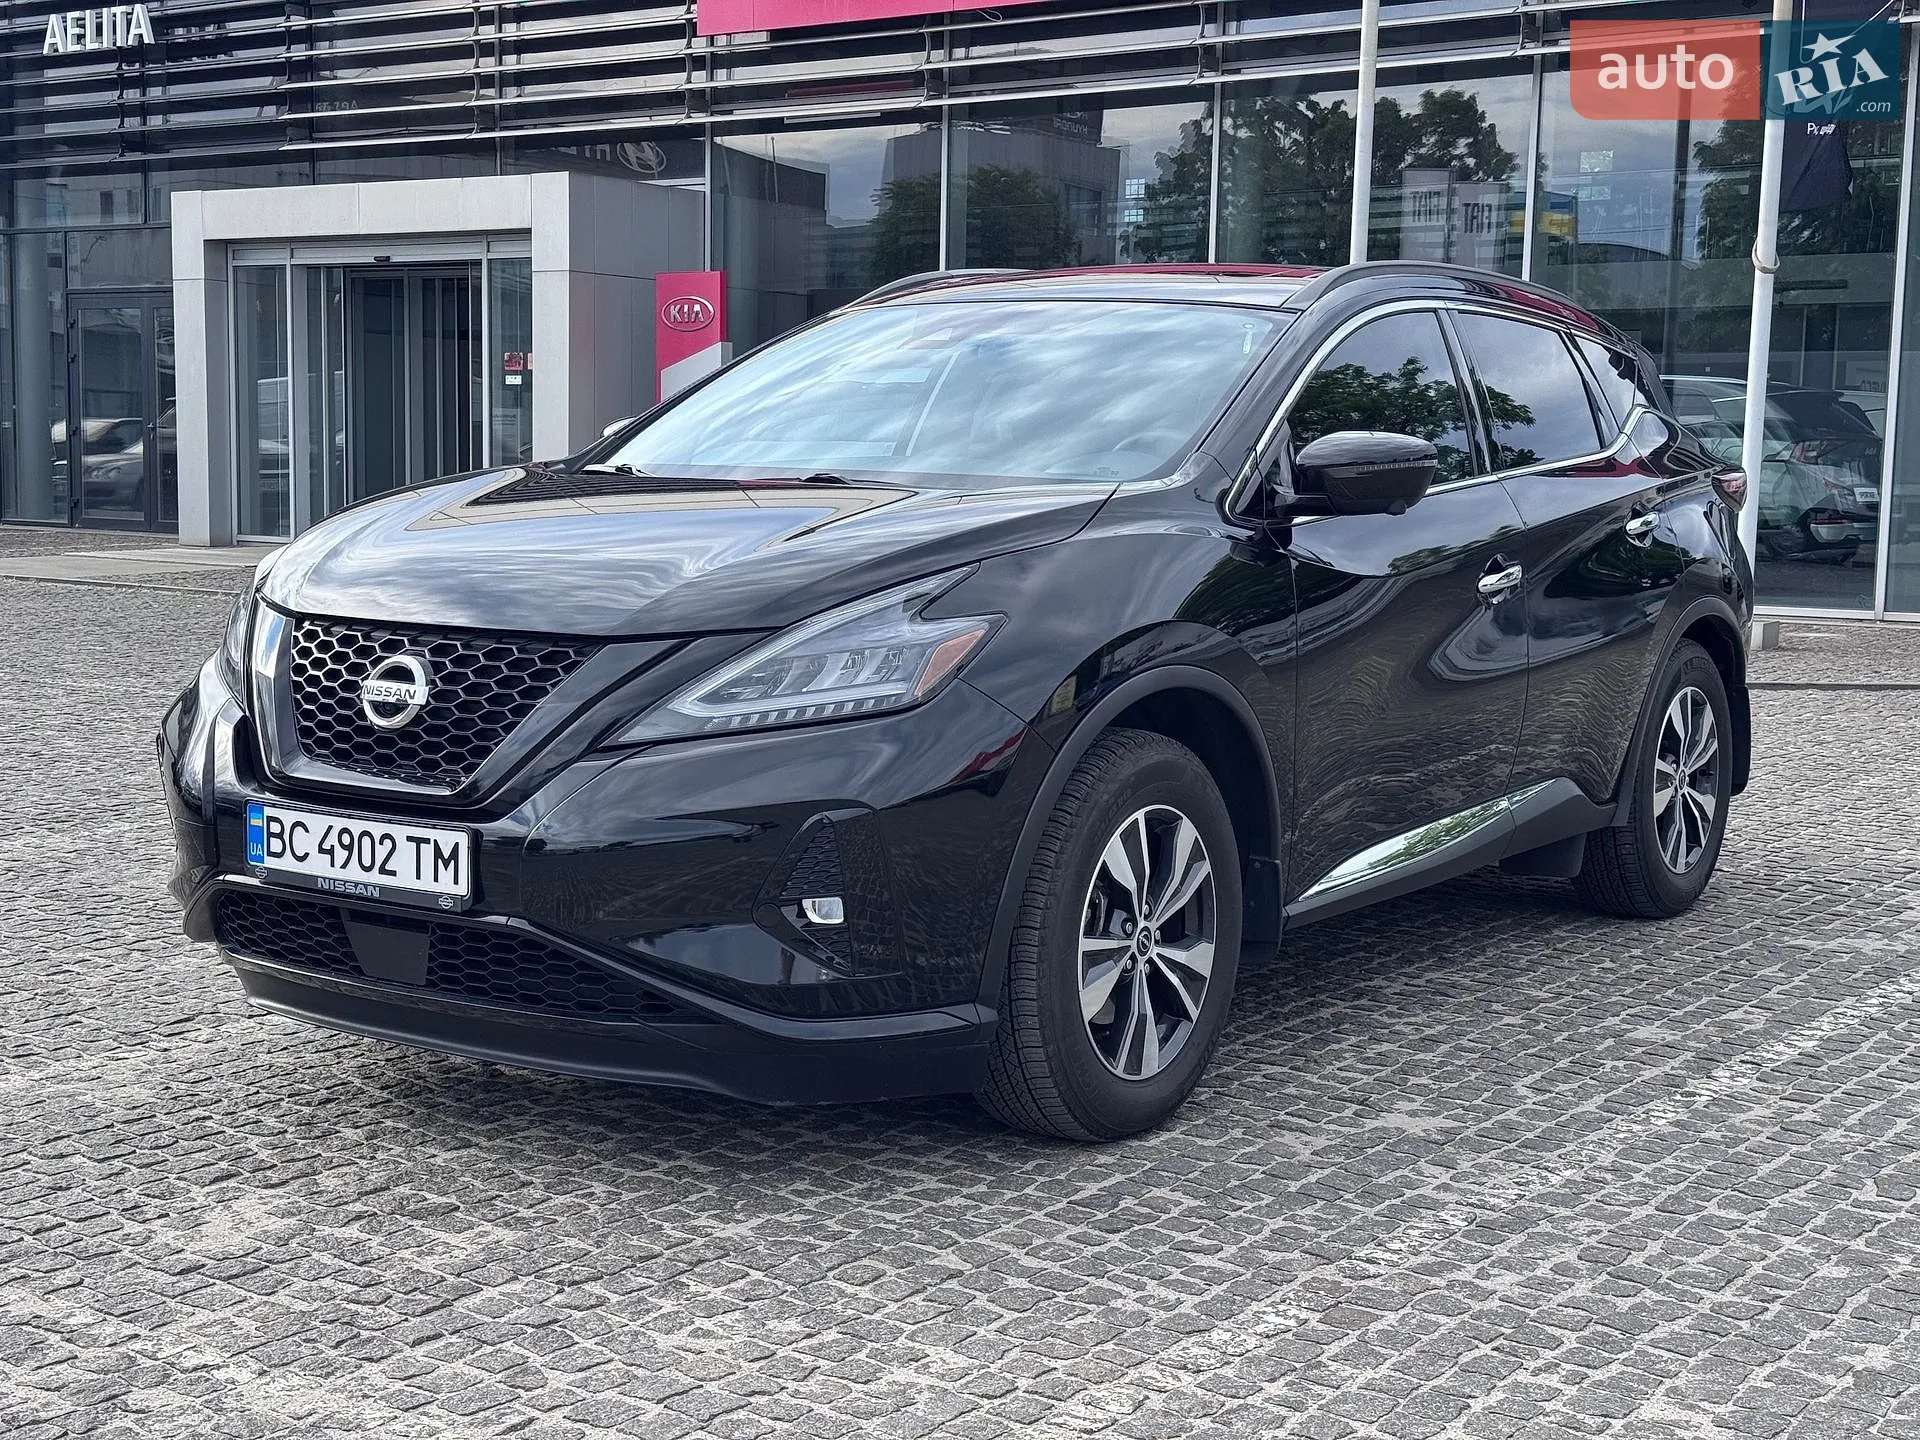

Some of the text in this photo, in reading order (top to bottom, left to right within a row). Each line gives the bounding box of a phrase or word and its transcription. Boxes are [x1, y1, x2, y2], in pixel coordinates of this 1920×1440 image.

[43, 4, 155, 56] AELITA
[670, 303, 705, 323] KIA
[364, 684, 417, 700] NISSAN
[250, 842, 264, 857] UA
[265, 815, 460, 886] BC 4902 TM
[317, 877, 380, 898] NISSAN
